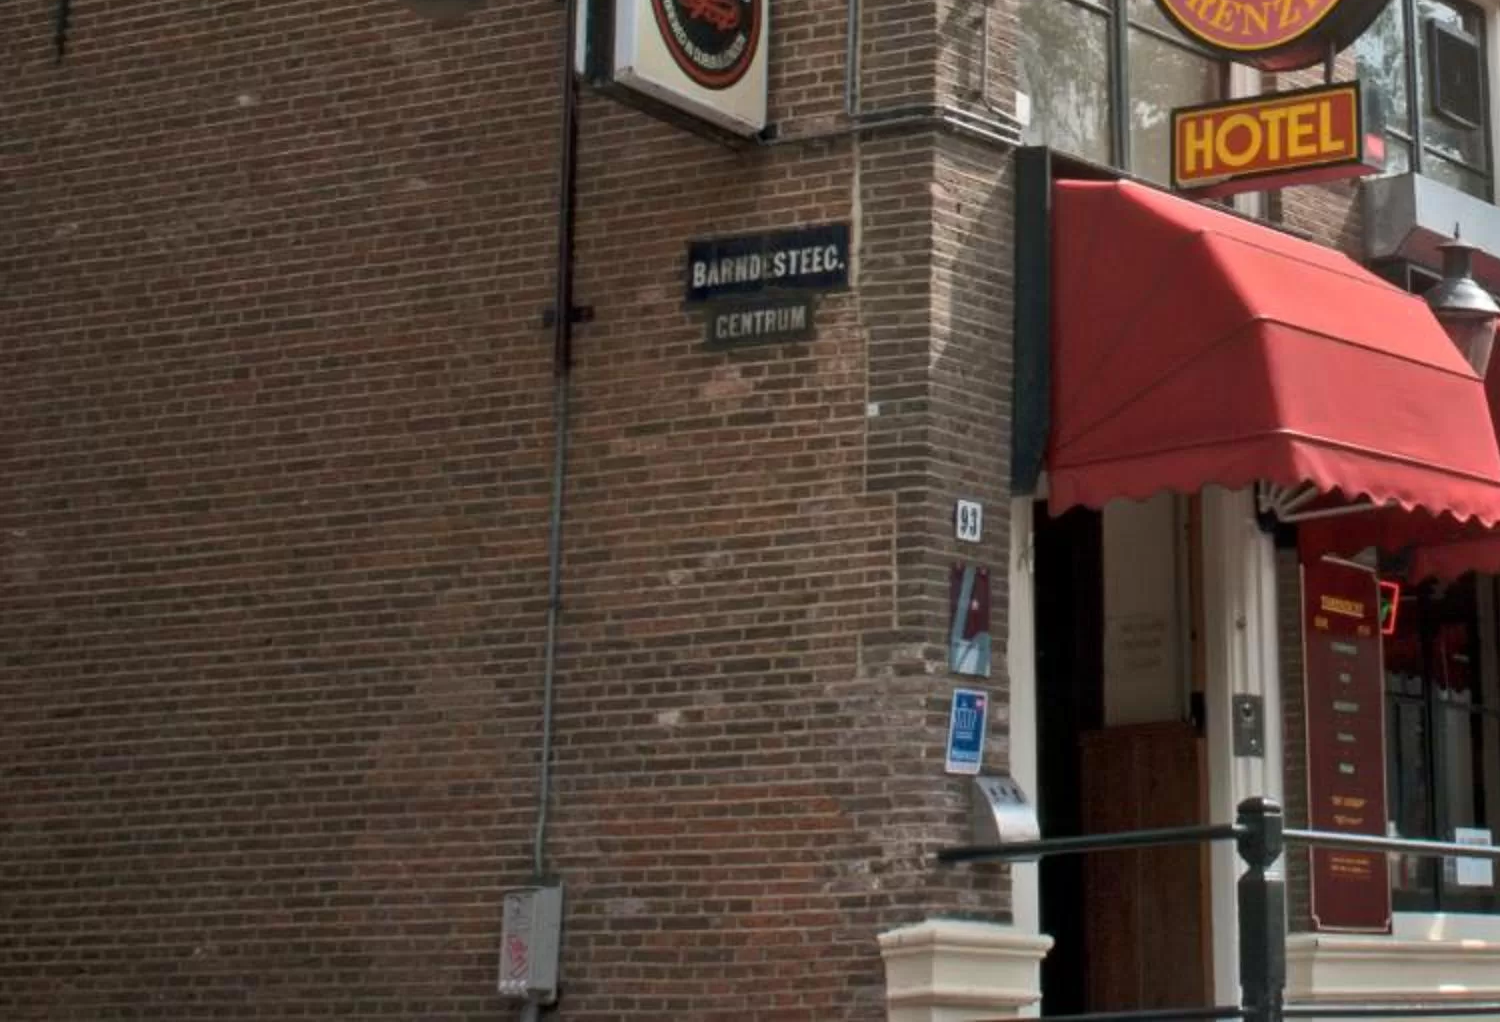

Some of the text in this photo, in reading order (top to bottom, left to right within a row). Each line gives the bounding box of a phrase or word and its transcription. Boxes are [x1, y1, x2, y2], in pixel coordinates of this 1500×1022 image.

[1184, 100, 1345, 173] HOTEL
[715, 304, 808, 339] CENTRUM
[960, 504, 978, 537] 93
